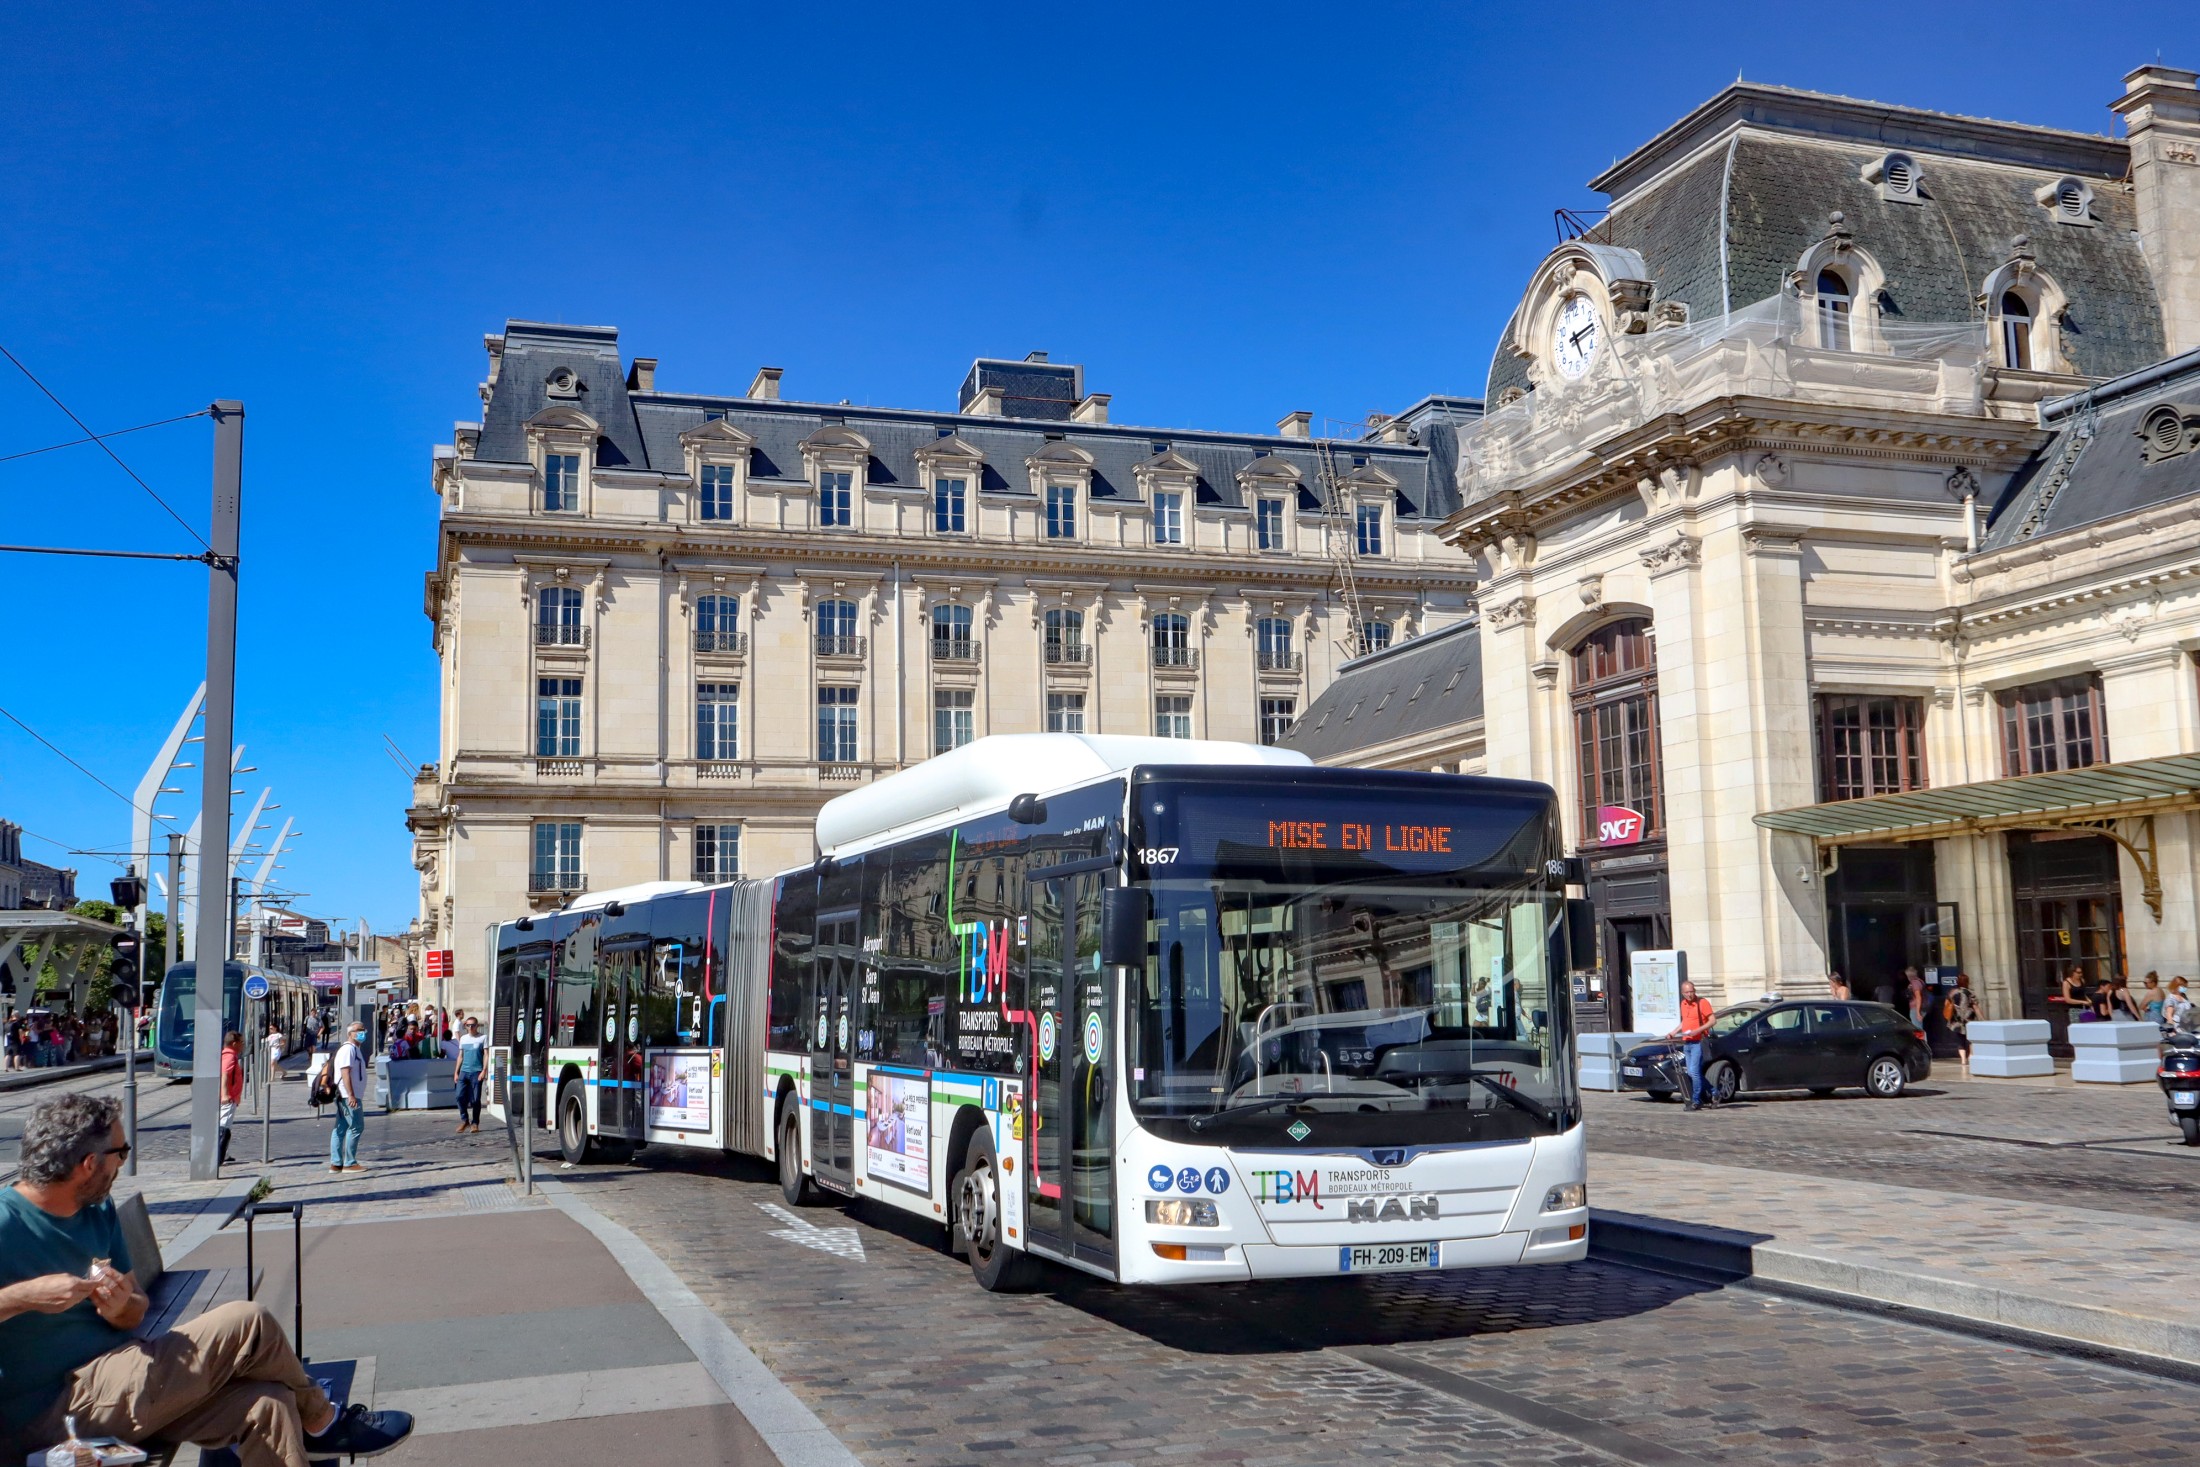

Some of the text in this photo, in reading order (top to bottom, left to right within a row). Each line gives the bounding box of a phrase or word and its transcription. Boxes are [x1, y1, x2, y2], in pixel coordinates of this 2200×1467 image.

[1588, 310, 1593, 322] 2
[1559, 341, 1564, 353] 9
[1568, 360, 1573, 372] 7
[1575, 360, 1581, 372] 6
[1583, 352, 1589, 364] 5
[1083, 815, 1106, 832] MAN
[1599, 817, 1638, 842] SNCF
[1269, 820, 1452, 853] MISE EN LIGNE
[1137, 847, 1180, 865] 1867
[863, 933, 883, 955] Aéroport
[953, 917, 1009, 1004] TBM
[866, 968, 877, 985] Gare
[861, 987, 880, 1004] St Jean
[959, 1011, 999, 1031] TRANSPORTS
[958, 1033, 1013, 1053] BORDEAUX MÉTROPOLE
[988, 1084, 994, 1106] 1
[1291, 1126, 1307, 1135] CNG
[1328, 1169, 1390, 1182] TRANSPORTS
[1251, 1169, 1324, 1210] TBM
[1328, 1181, 1413, 1193] BORDEAUX MÉTROPOLE
[1345, 1194, 1440, 1223] MAN
[1353, 1246, 1428, 1266] FH-209-EM
[1430, 1255, 1438, 1264] 33
